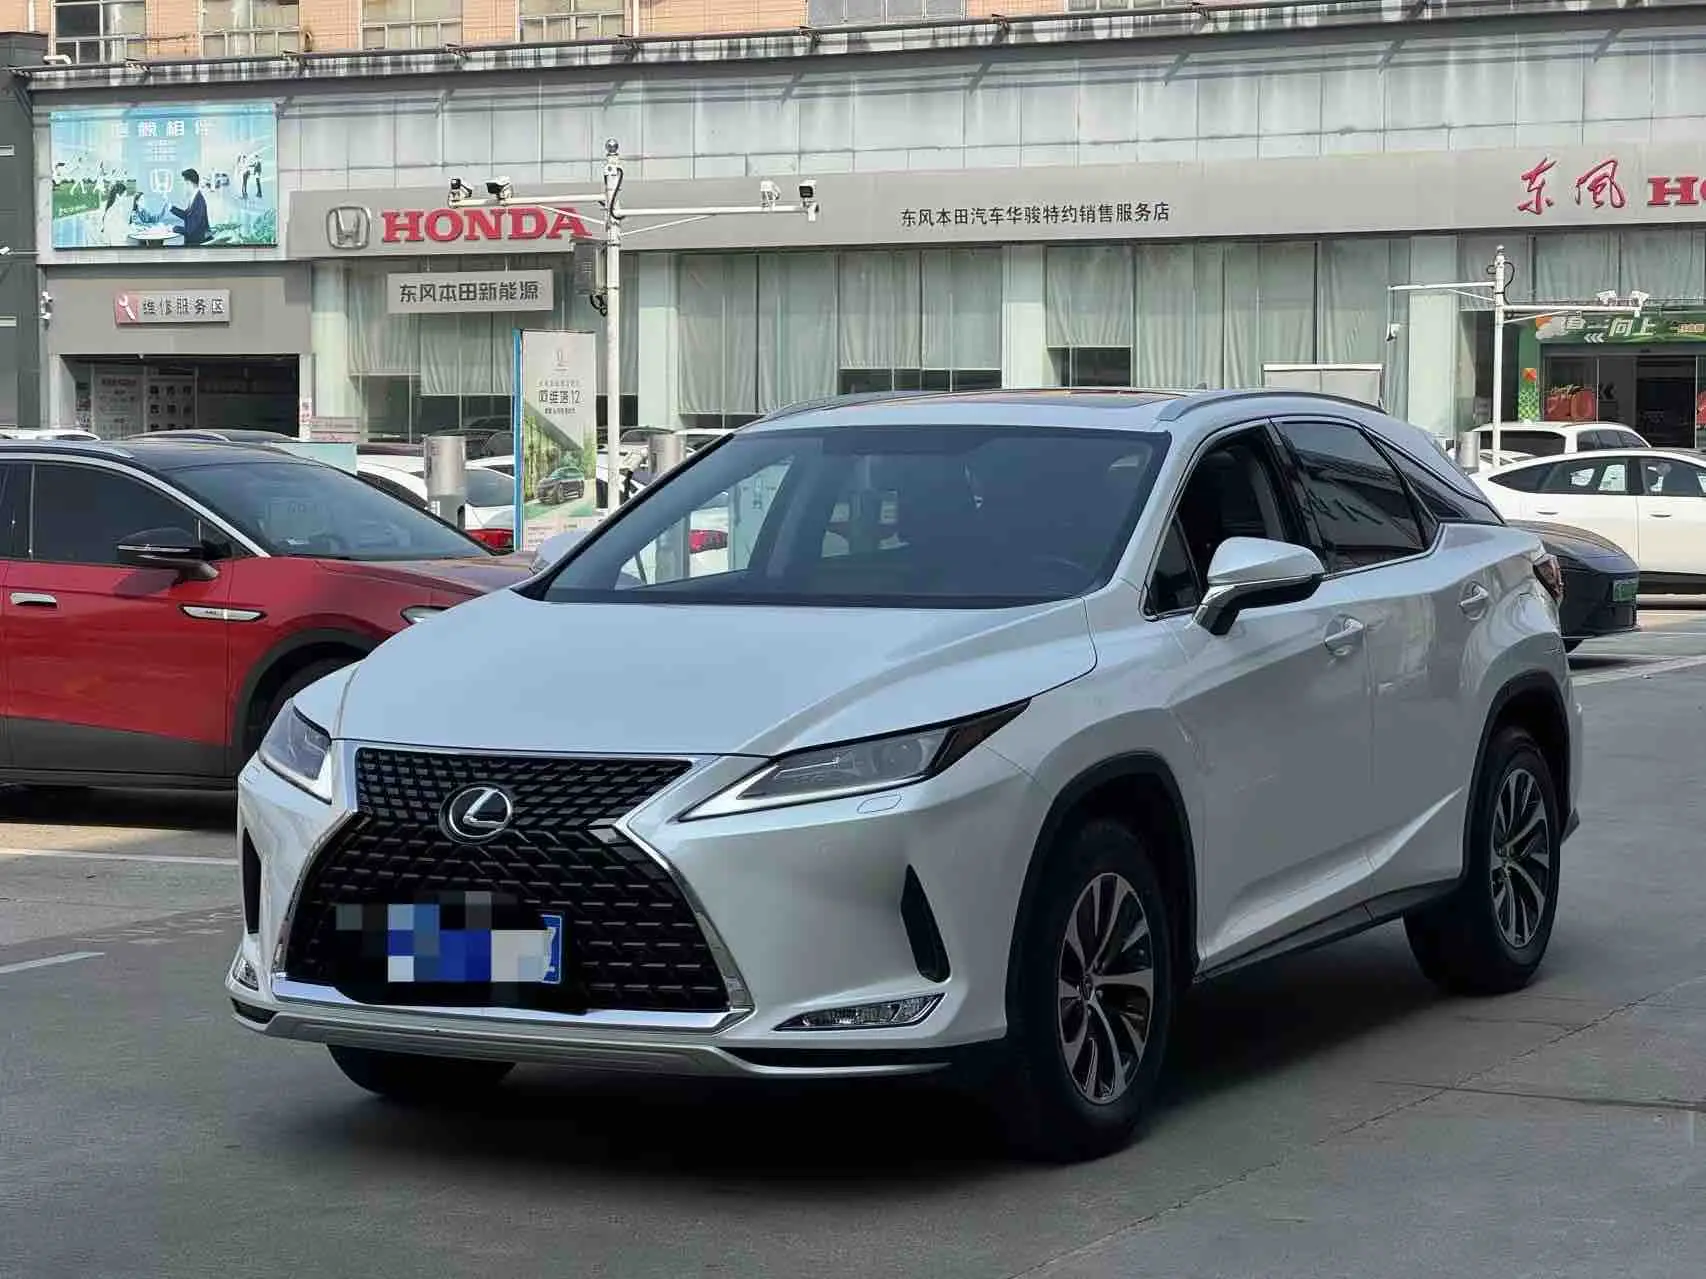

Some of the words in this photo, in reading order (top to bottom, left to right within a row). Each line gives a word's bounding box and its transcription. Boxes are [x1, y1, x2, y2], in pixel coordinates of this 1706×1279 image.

[1648, 176, 1706, 206] H
[381, 207, 592, 243] HONDA
[900, 201, 1170, 228] 东风本田汽车华骏特约销售服务店
[143, 296, 225, 316] 维修服务区
[399, 280, 540, 305] 东风本田新能源
